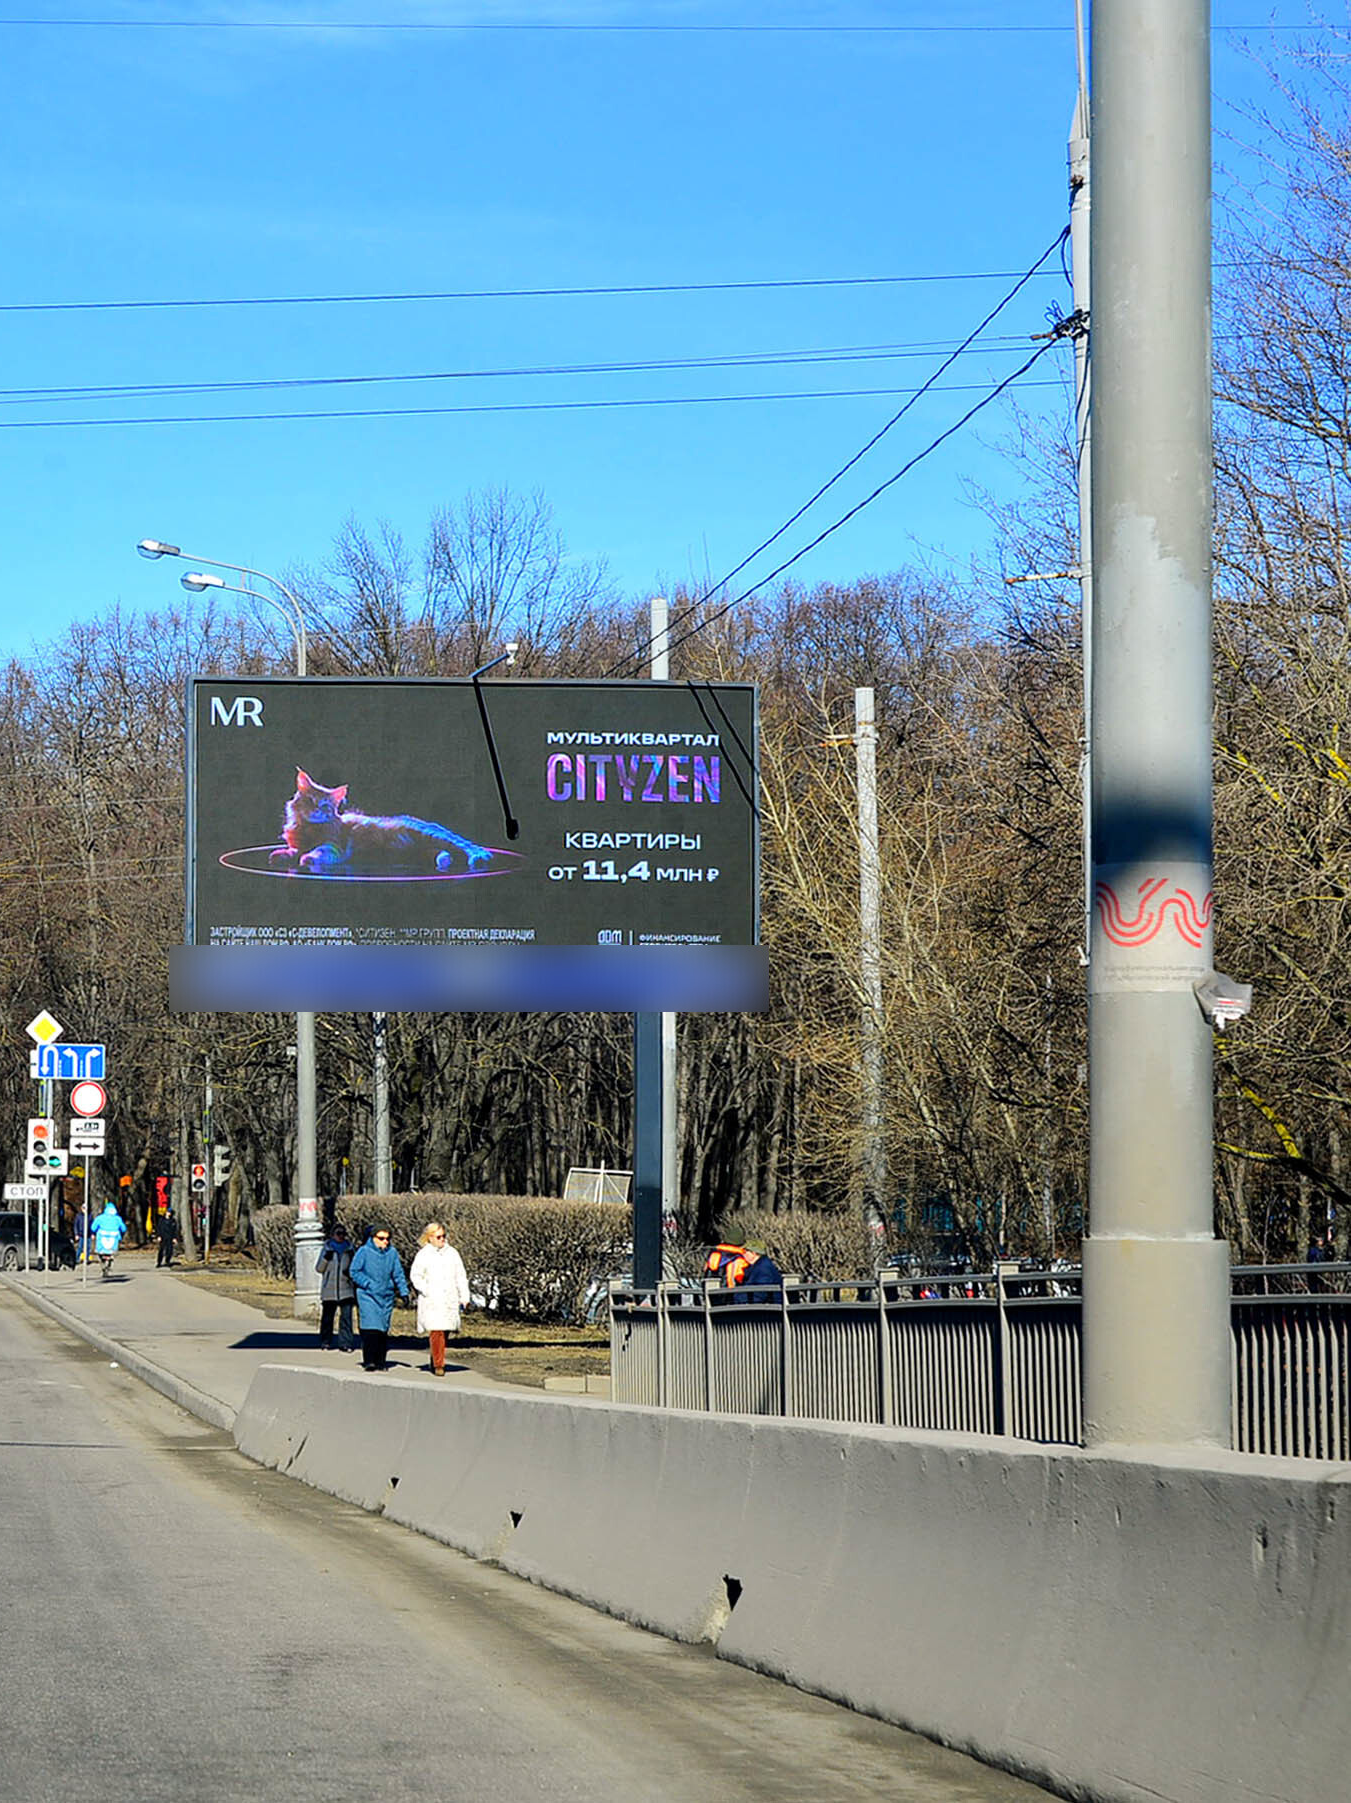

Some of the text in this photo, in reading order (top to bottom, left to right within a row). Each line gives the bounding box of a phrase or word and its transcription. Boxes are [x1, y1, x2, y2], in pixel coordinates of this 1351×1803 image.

[211, 696, 265, 727] MR
[547, 732, 720, 746] МУЛЬТИКВАРТАЛ
[547, 753, 721, 802] CITYZEN
[565, 832, 701, 850] КВАРТИРЫ
[582, 859, 651, 883] 11,4
[656, 868, 703, 882] МЛН
[10, 1187, 43, 1196] СТОП
